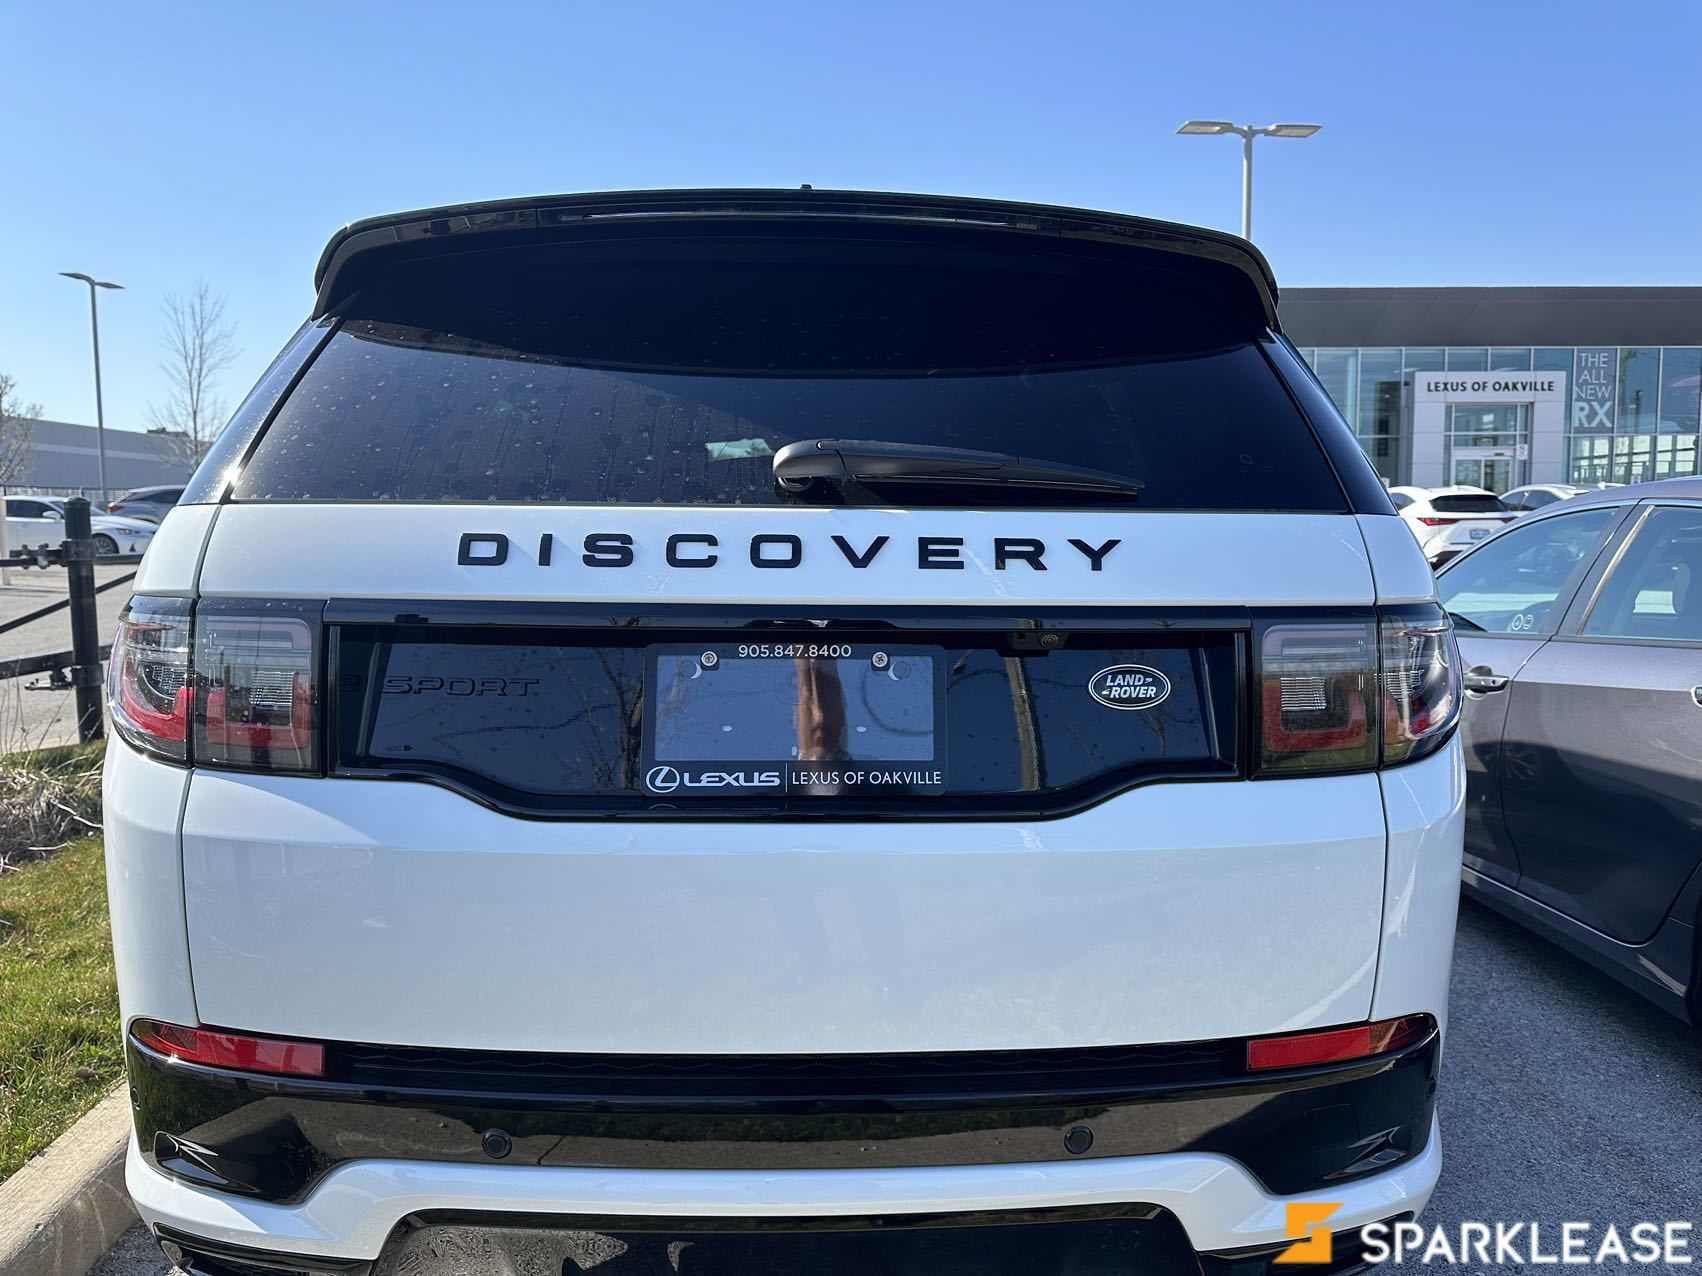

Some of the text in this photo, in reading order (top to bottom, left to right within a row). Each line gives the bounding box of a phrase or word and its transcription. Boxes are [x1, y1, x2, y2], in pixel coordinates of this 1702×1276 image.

[1579, 352, 1609, 367] THE
[1578, 369, 1607, 384] ALL
[1426, 380, 1555, 392] LEXUS OF OAKVILLE
[1574, 385, 1612, 399] NEW
[1574, 401, 1613, 427] RX
[457, 532, 1123, 572] DISCOVERY
[737, 644, 852, 658] 905.847.8400
[383, 675, 544, 697] SPORT
[1106, 674, 1145, 686] LAND
[1109, 686, 1157, 698] ROVER
[683, 771, 781, 787] LEXUS
[791, 771, 942, 785] LEXUS OF OAKVILLE
